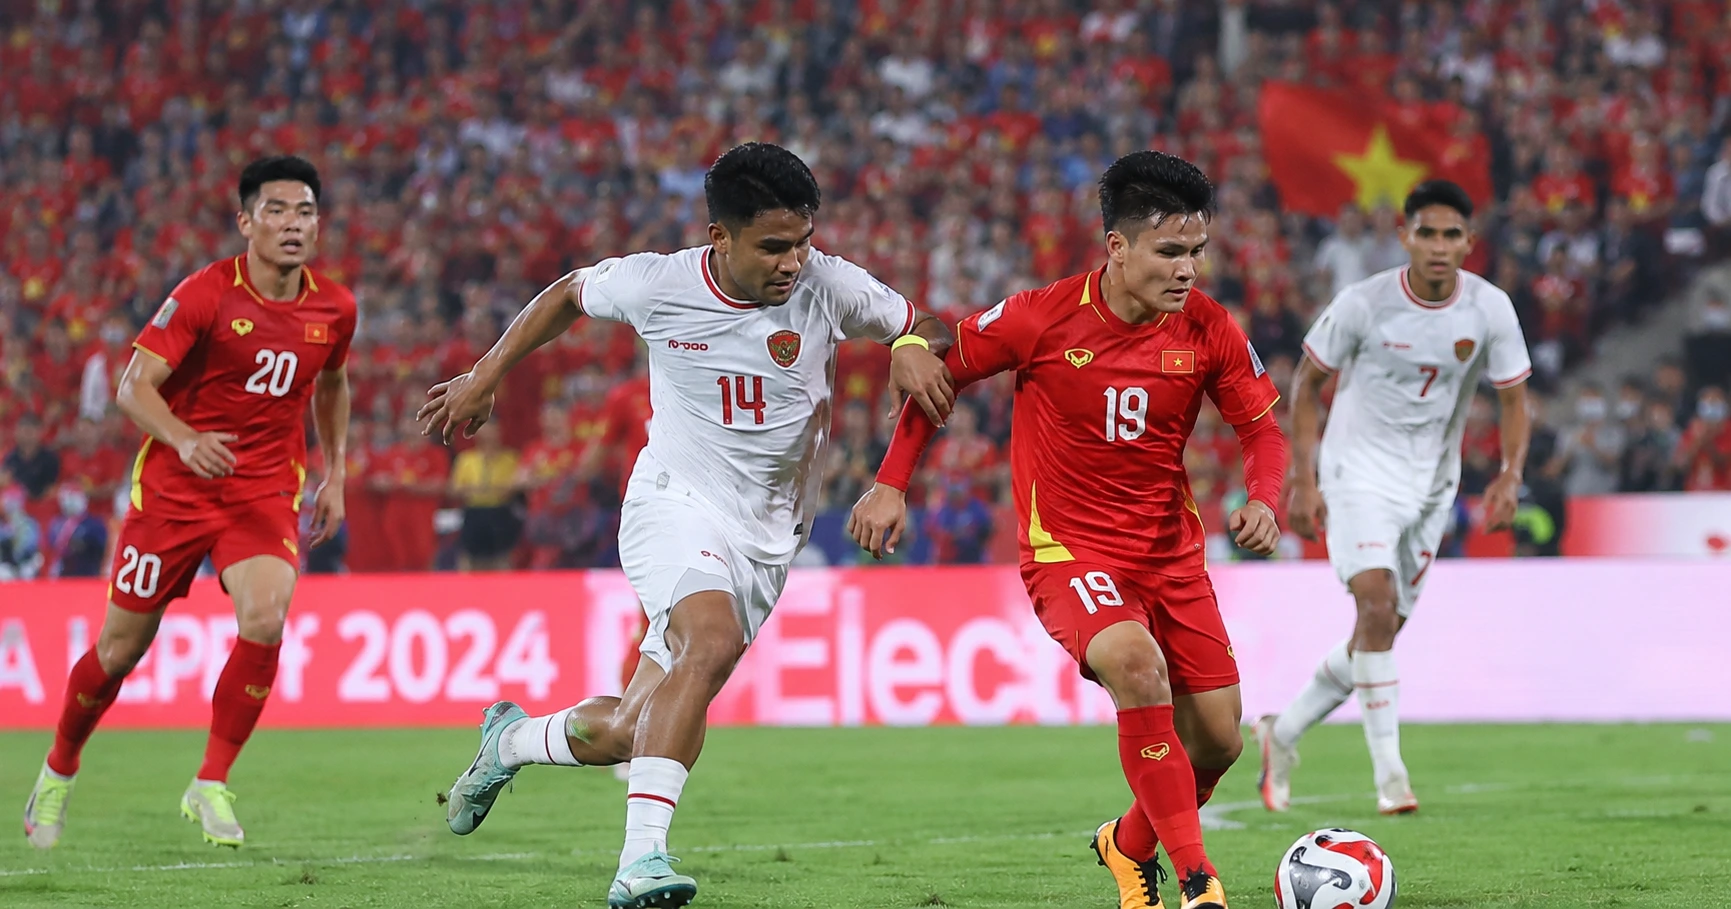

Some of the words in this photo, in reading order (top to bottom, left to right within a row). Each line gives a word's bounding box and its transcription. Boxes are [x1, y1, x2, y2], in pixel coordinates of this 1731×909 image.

[245, 349, 298, 397] 20
[1418, 366, 1439, 398] 7
[717, 375, 767, 425] 14
[1103, 386, 1149, 442] 19
[116, 545, 162, 598] 20
[1069, 571, 1124, 615] 19
[1410, 549, 1432, 588] 7
[337, 608, 559, 702] 2024
